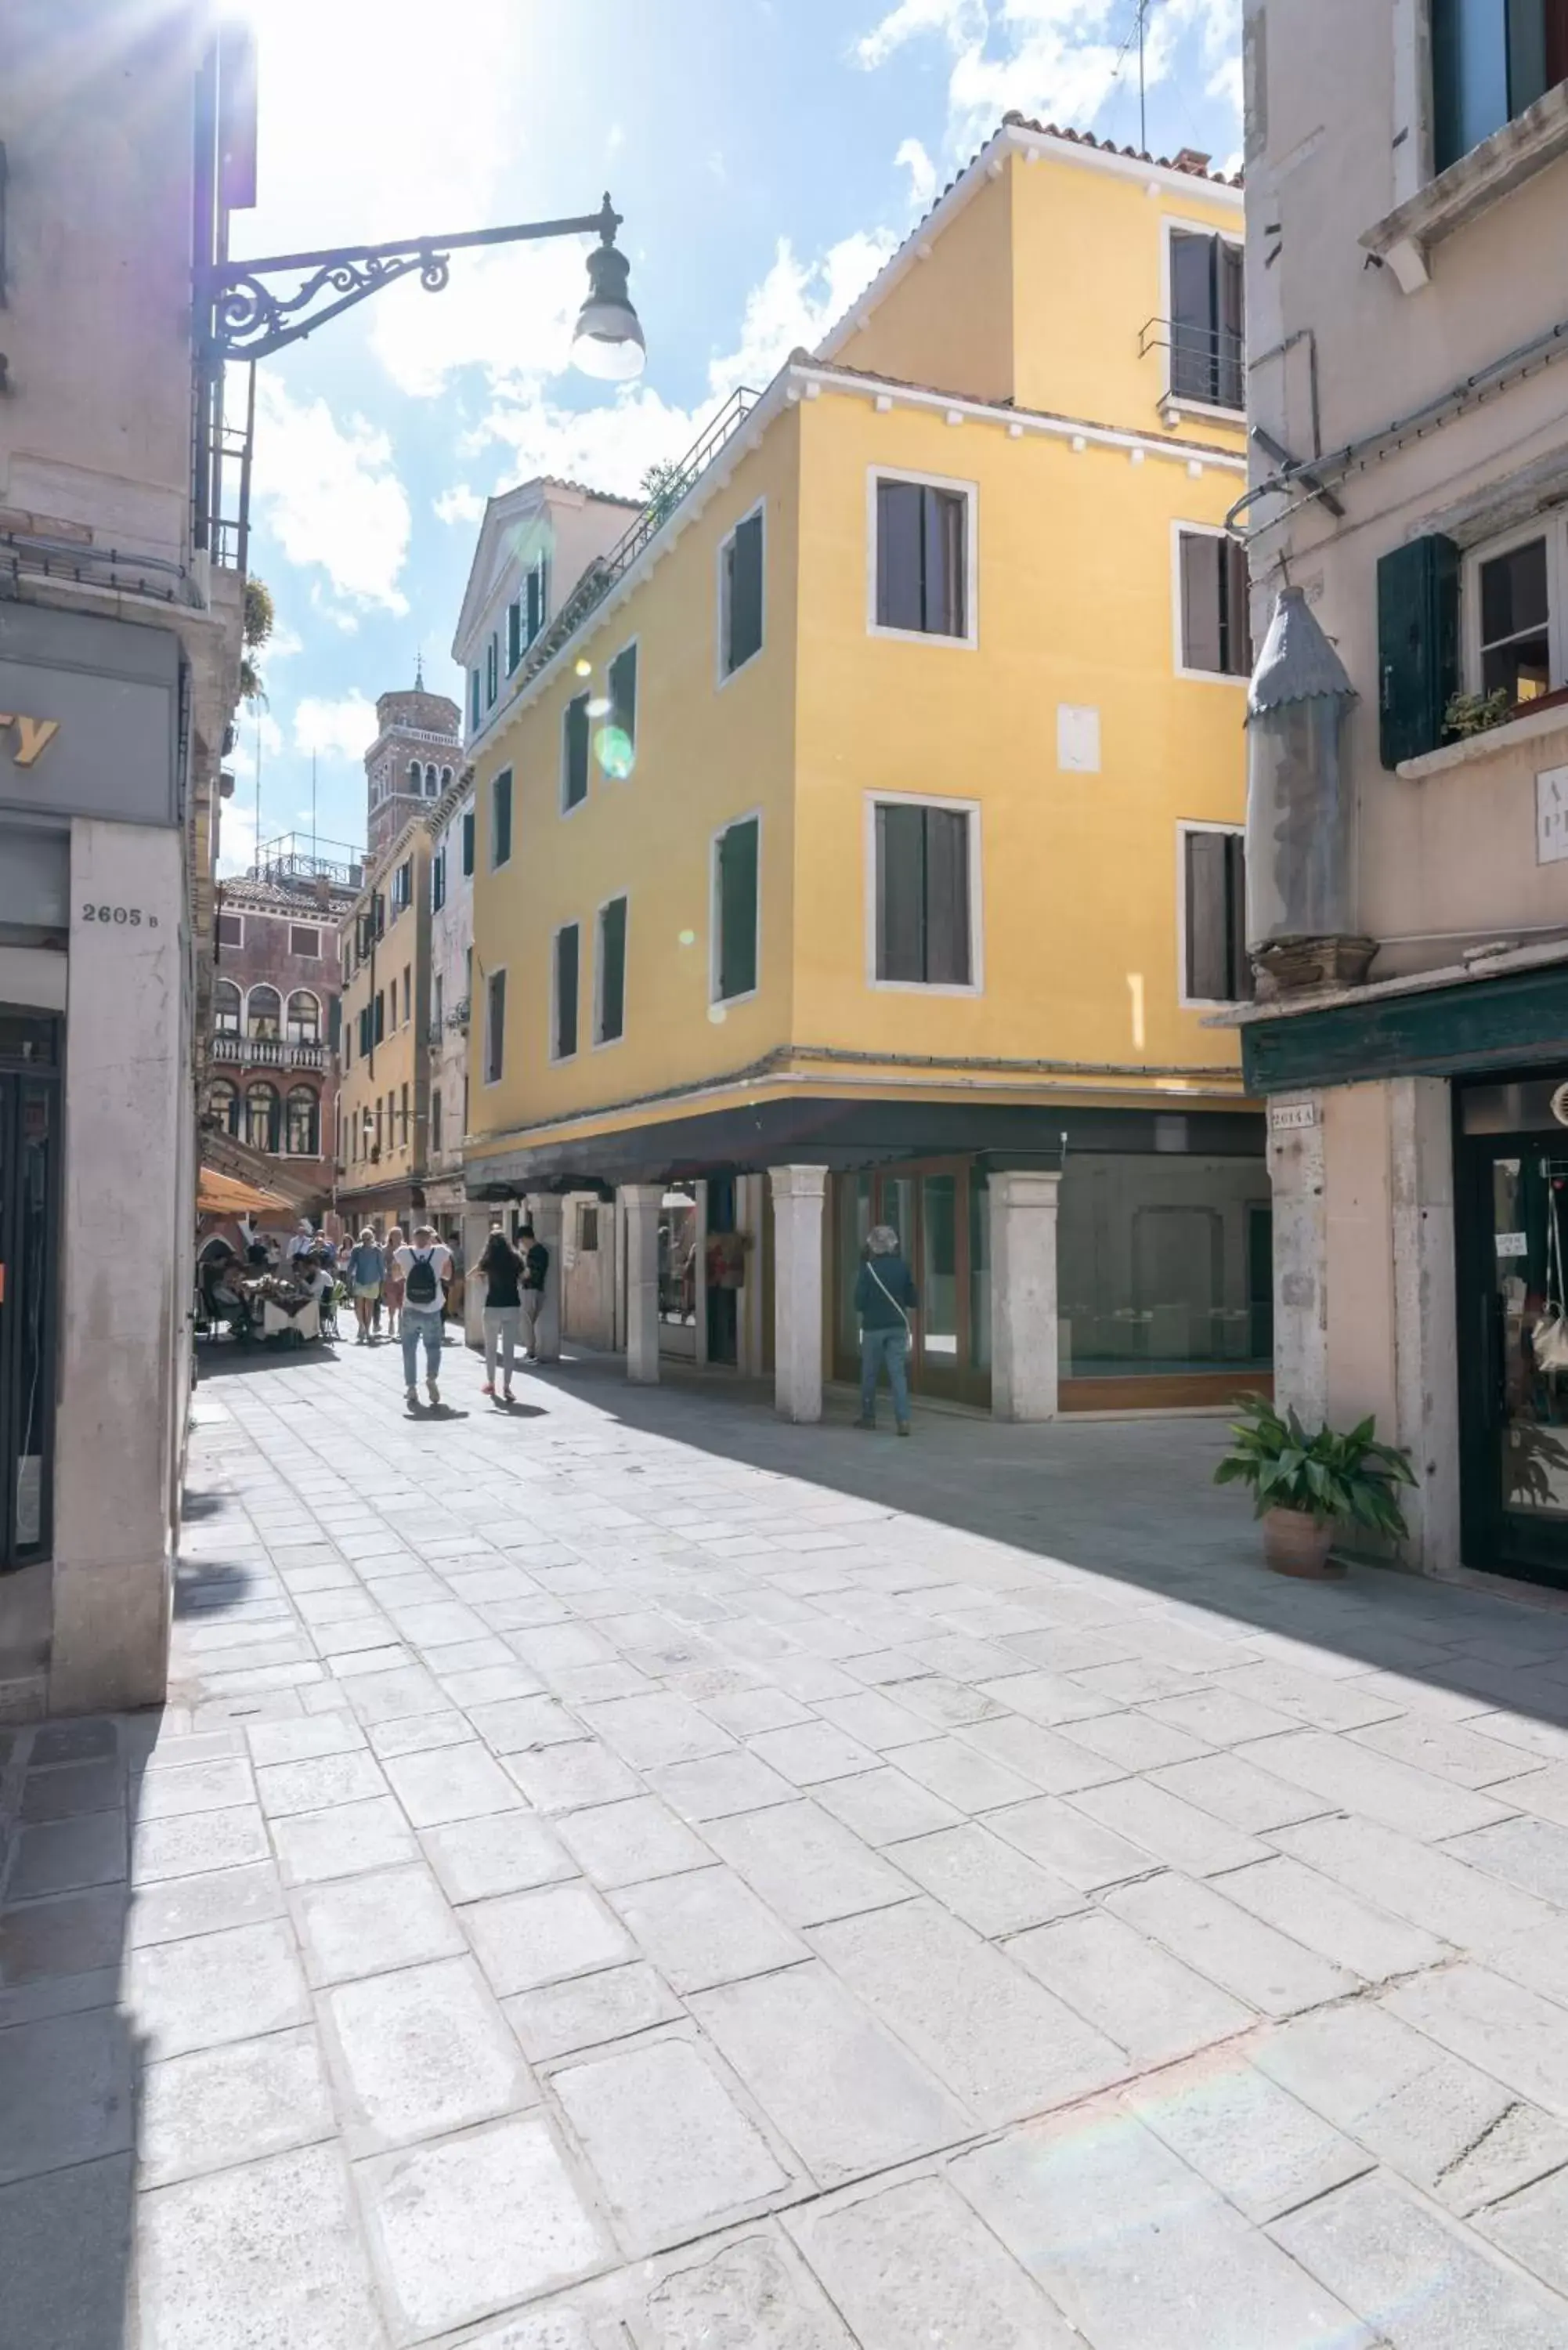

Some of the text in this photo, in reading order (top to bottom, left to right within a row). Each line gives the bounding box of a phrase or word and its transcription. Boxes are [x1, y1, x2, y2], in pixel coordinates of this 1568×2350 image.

[1545, 809, 1568, 837] P
[81, 903, 158, 928] 2605 B
